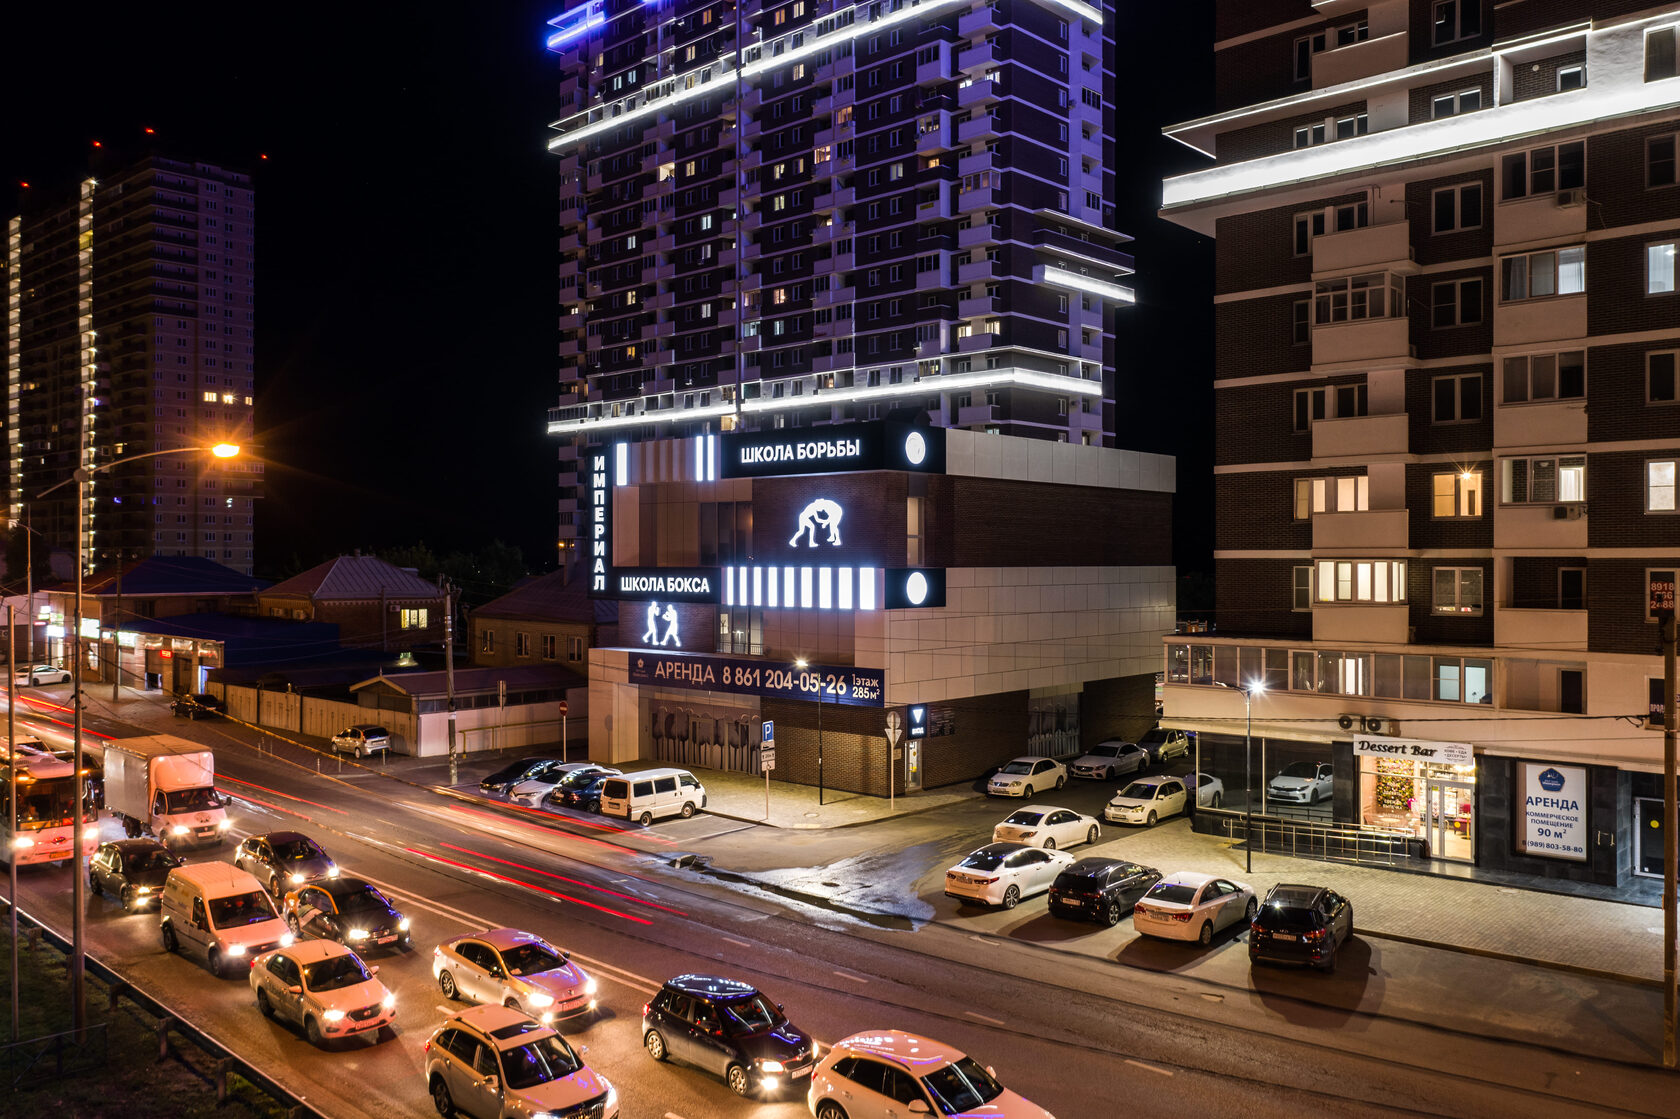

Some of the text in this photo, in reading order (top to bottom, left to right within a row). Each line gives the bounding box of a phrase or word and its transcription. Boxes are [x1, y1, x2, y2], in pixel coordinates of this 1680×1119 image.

[741, 439, 860, 463] ШКОЛА БОРЬБЫ
[593, 455, 606, 591] ИМПЕРИАЛ
[621, 576, 710, 593] ШКОЛА БОКСА
[1650, 582, 1674, 591] 8918
[654, 661, 716, 685] АРЕНДА
[722, 666, 731, 685] 8
[735, 667, 761, 687] 861
[765, 669, 847, 695] 204-05-26
[1358, 740, 1438, 757] Dessert Bar
[1525, 796, 1579, 811] АРЕНДА
[1525, 811, 1579, 822] КОММЕРЧЕСКОЕ
[1530, 818, 1573, 828] ПОМЕЩЕНИЕ
[1537, 828, 1551, 837] 90
